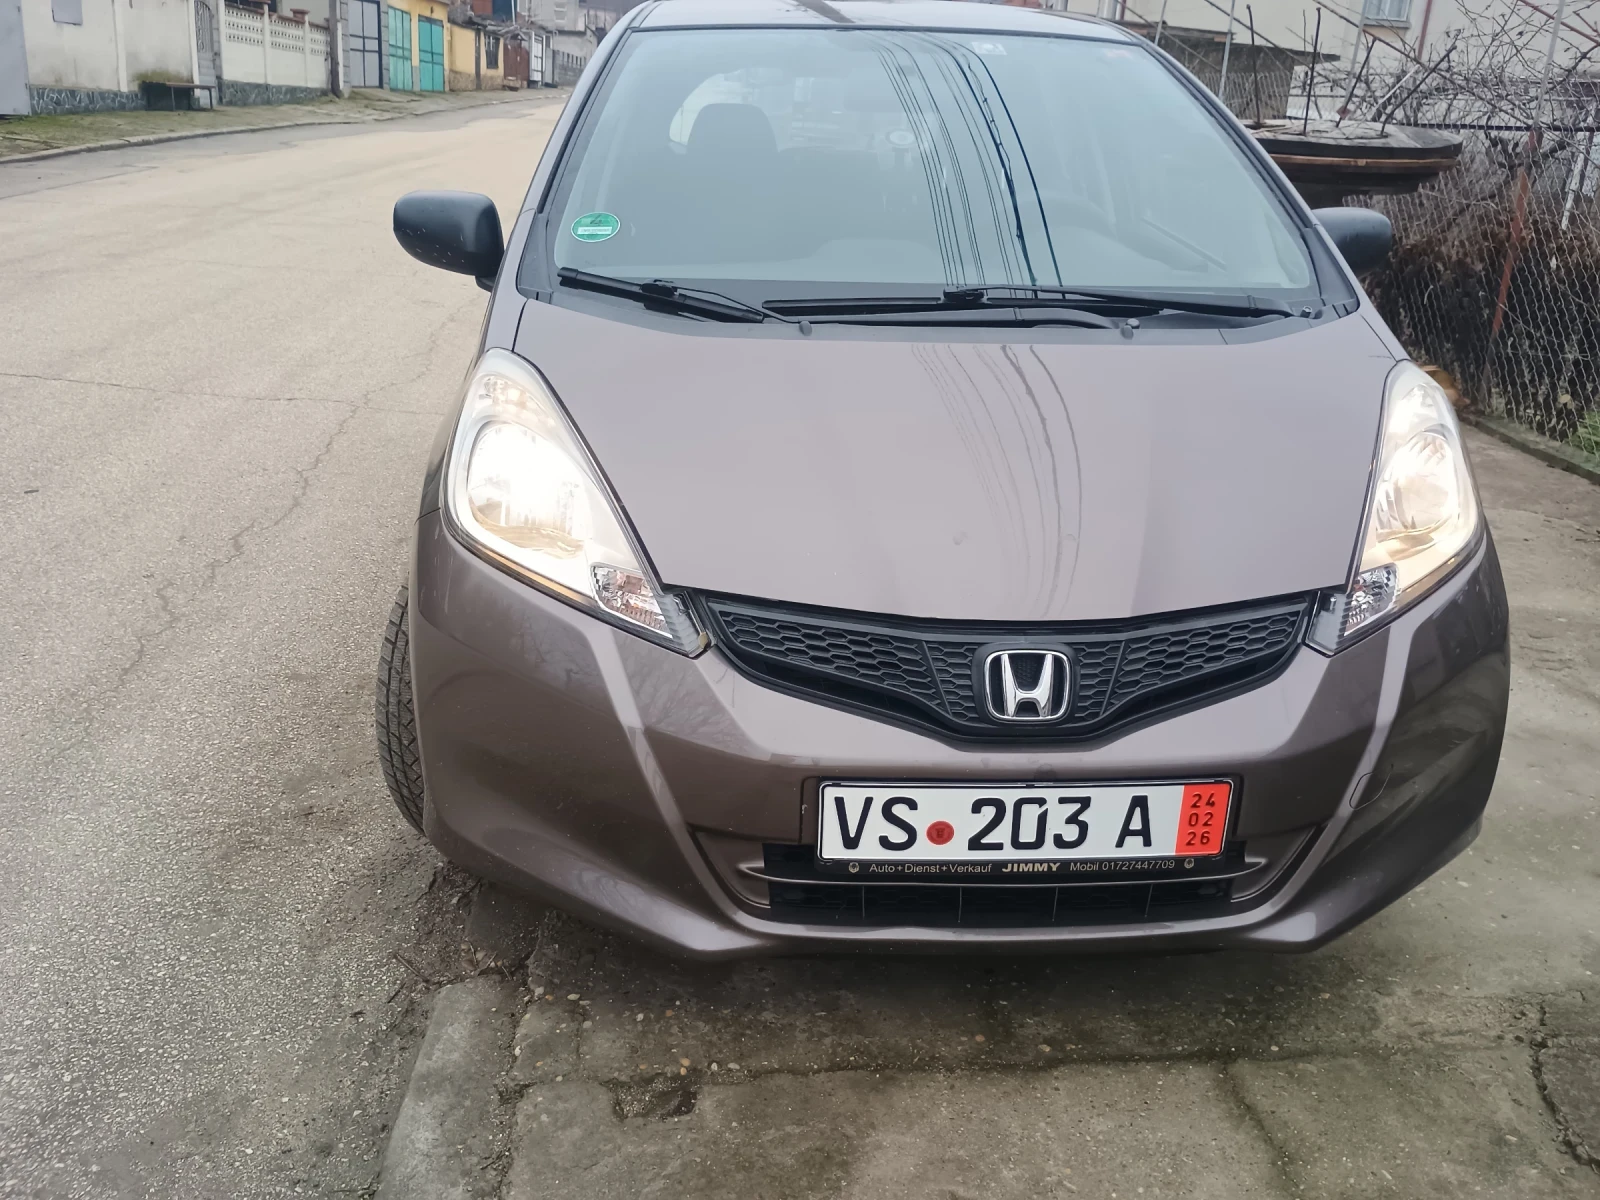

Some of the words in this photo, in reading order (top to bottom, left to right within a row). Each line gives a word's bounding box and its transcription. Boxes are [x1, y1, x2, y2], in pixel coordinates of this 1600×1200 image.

[1190, 792, 1216, 808] 24
[833, 795, 919, 851] VS
[967, 795, 1092, 851] 203
[1114, 795, 1153, 849] A
[1188, 811, 1214, 827] 02
[1185, 830, 1211, 846] 26
[1001, 862, 1061, 873] JIMMY
[1069, 861, 1100, 872] Mobil
[1101, 859, 1176, 871] 01727447709
